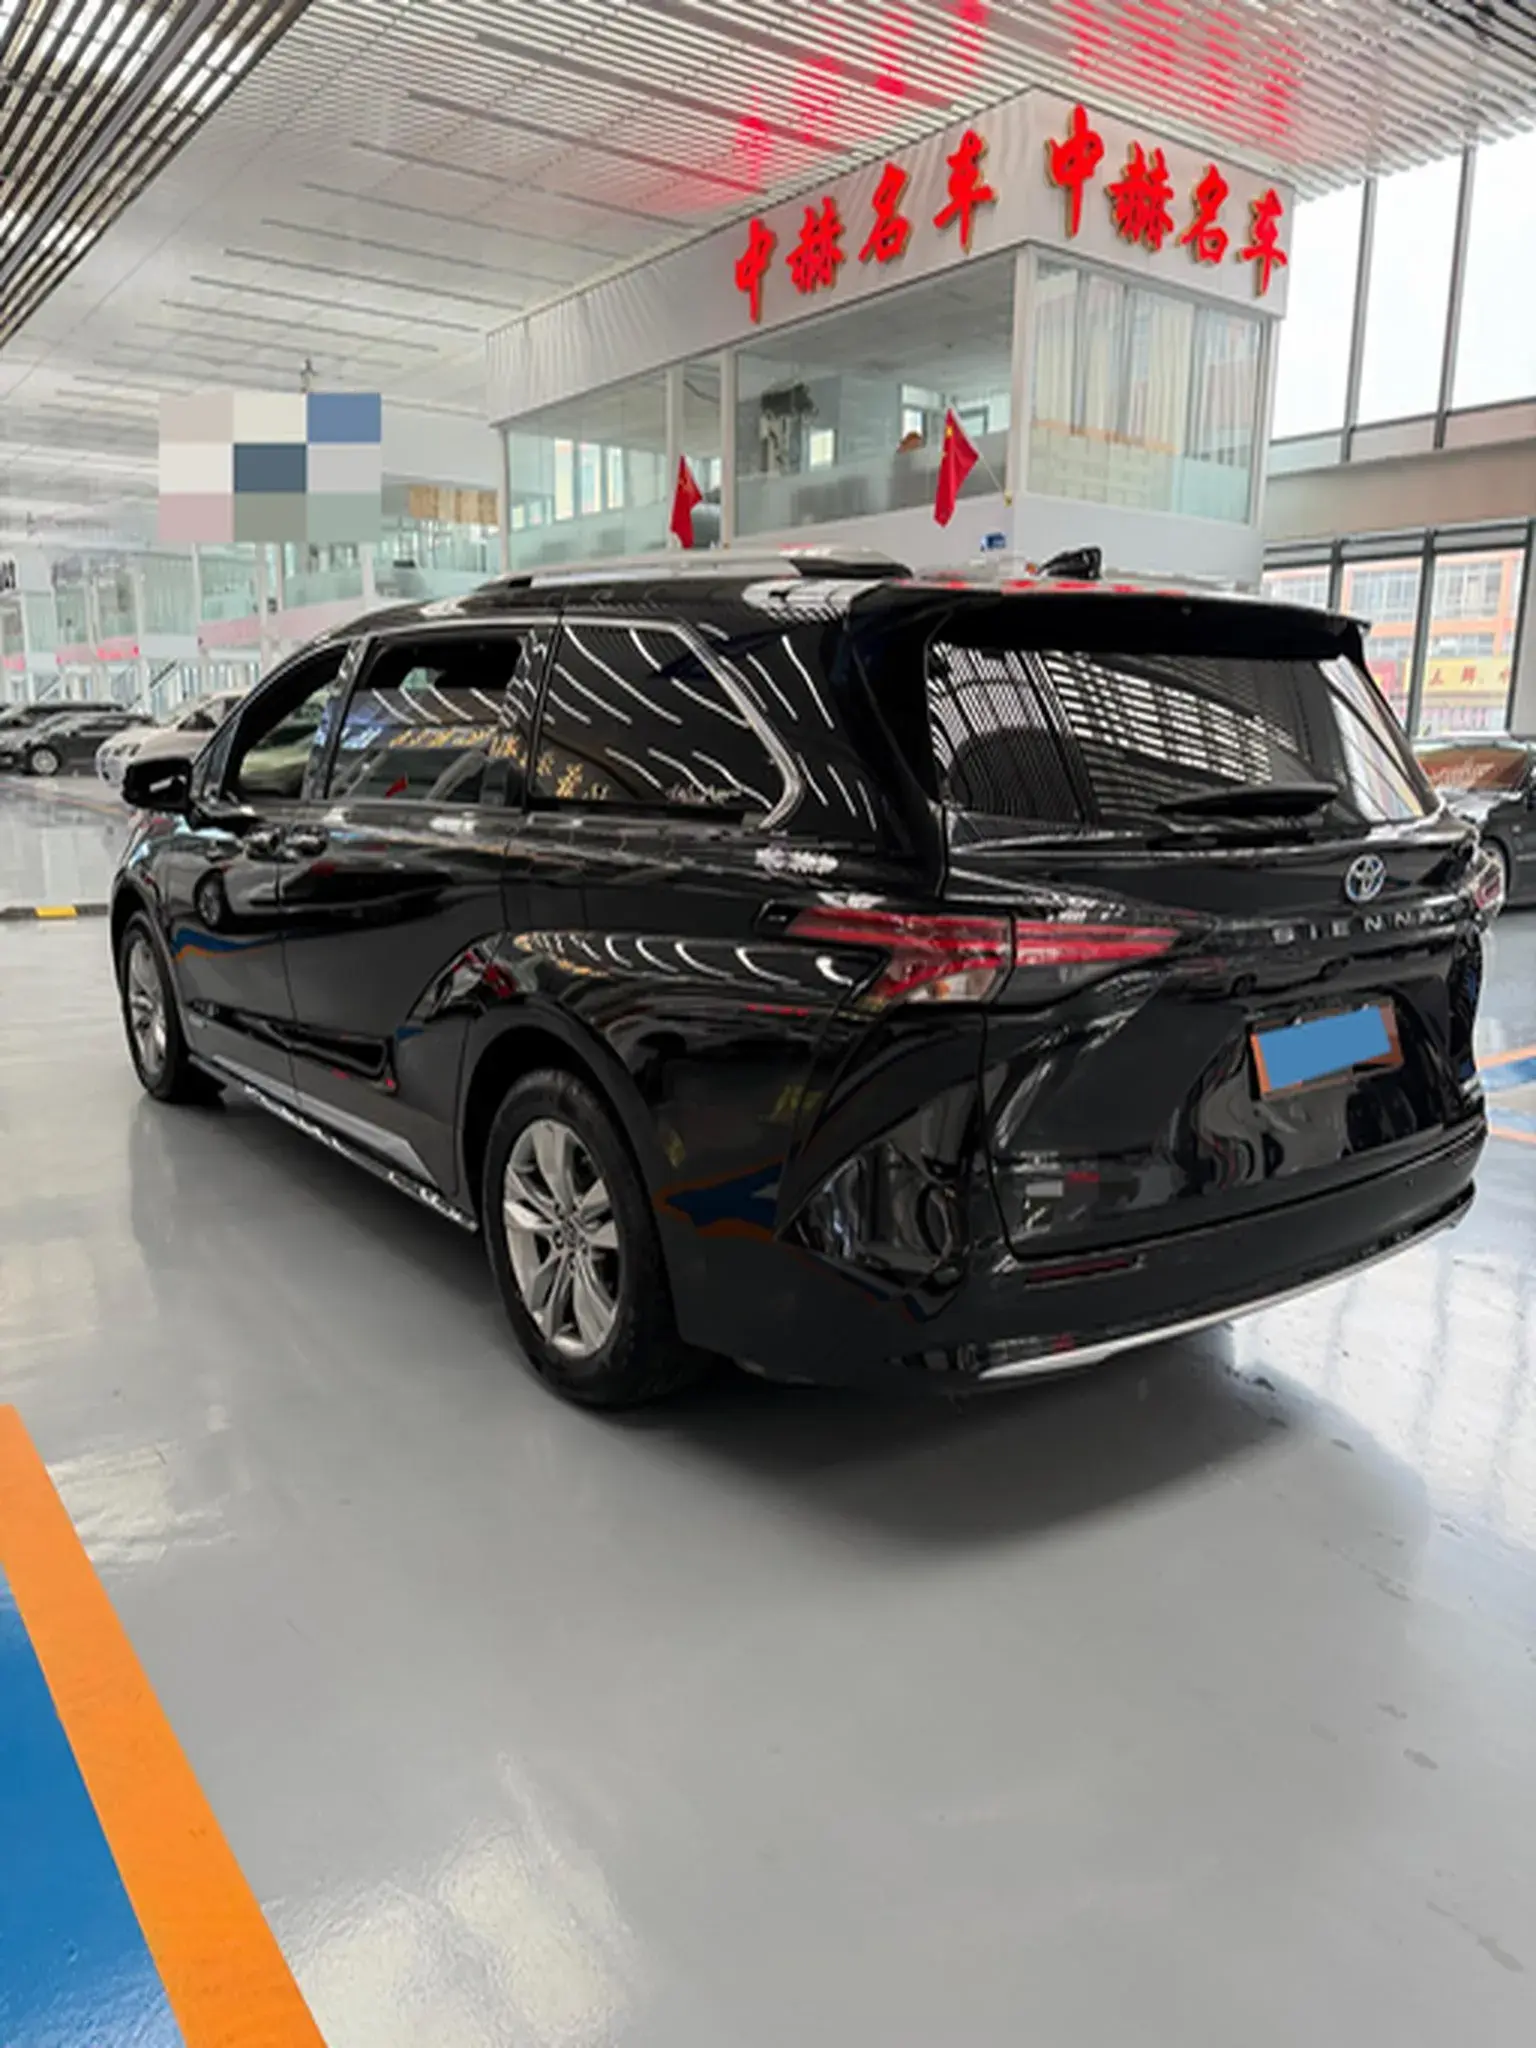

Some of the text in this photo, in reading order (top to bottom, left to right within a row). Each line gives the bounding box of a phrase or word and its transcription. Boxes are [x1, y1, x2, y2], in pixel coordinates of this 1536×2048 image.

[734, 130, 996, 323] 中赫名车
[1046, 103, 1289, 297] 中赫名车
[1272, 908, 1438, 945] SIENNA
